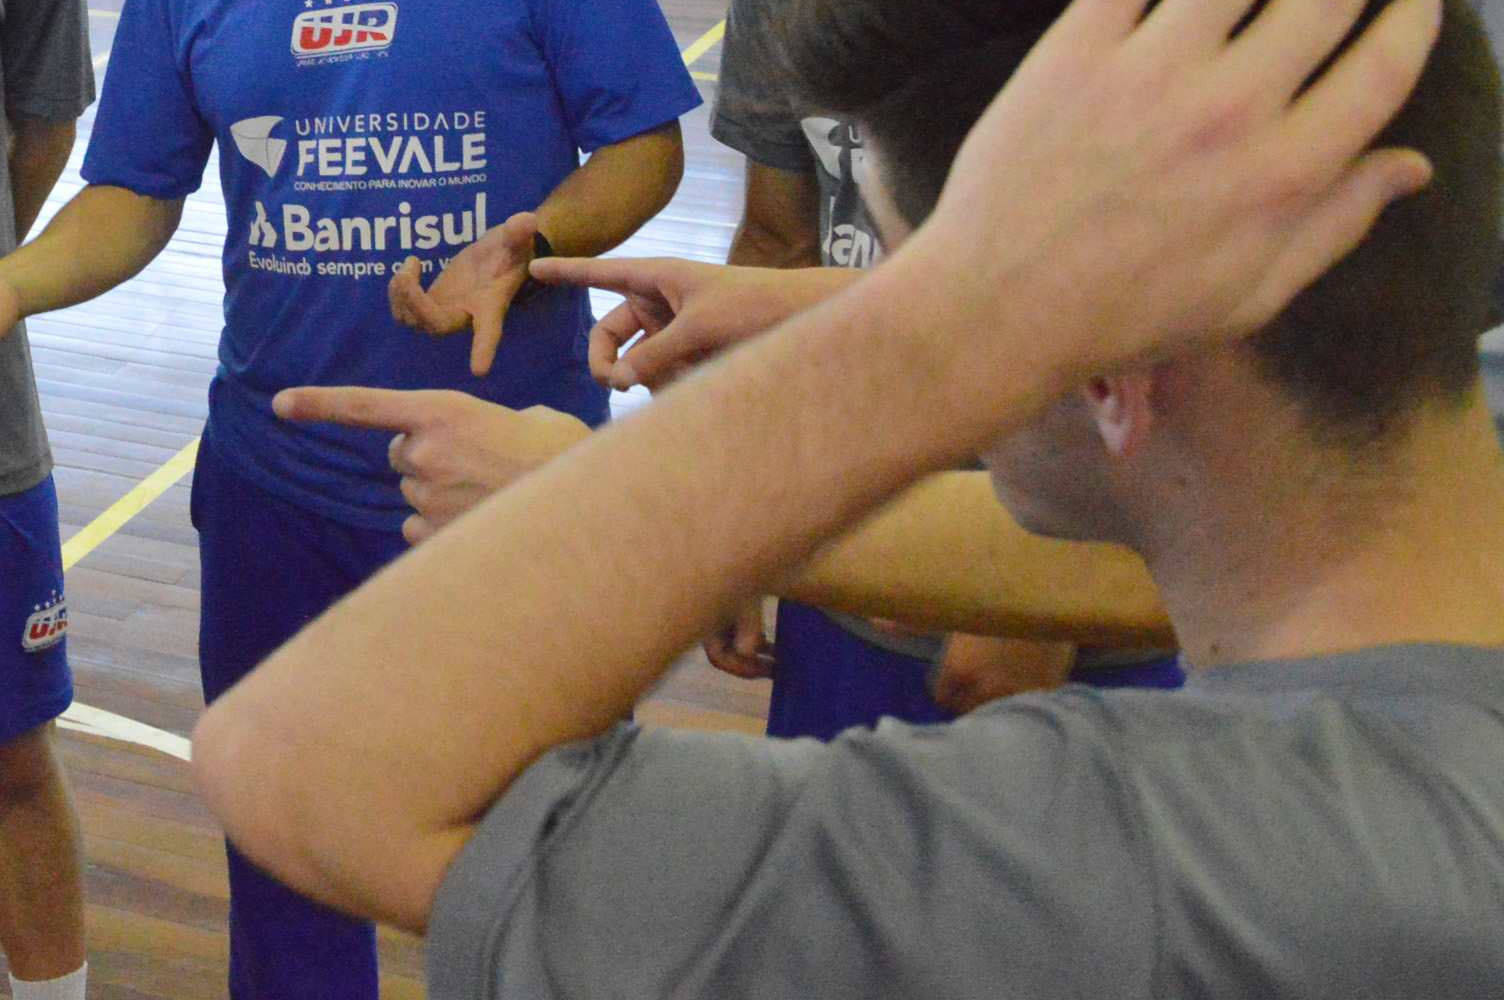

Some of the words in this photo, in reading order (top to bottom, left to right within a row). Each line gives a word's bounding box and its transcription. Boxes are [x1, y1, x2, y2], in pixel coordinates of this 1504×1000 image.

[300, 9, 389, 50] UJR
[295, 111, 486, 136] UNIVERSIDADE
[297, 133, 487, 176] FEEVALE
[369, 179, 396, 190] PARA
[398, 178, 436, 189] INOVAR
[438, 177, 446, 187] O
[448, 173, 487, 186] MUNDO
[282, 192, 486, 252] Banrisul
[317, 260, 386, 280] sempre
